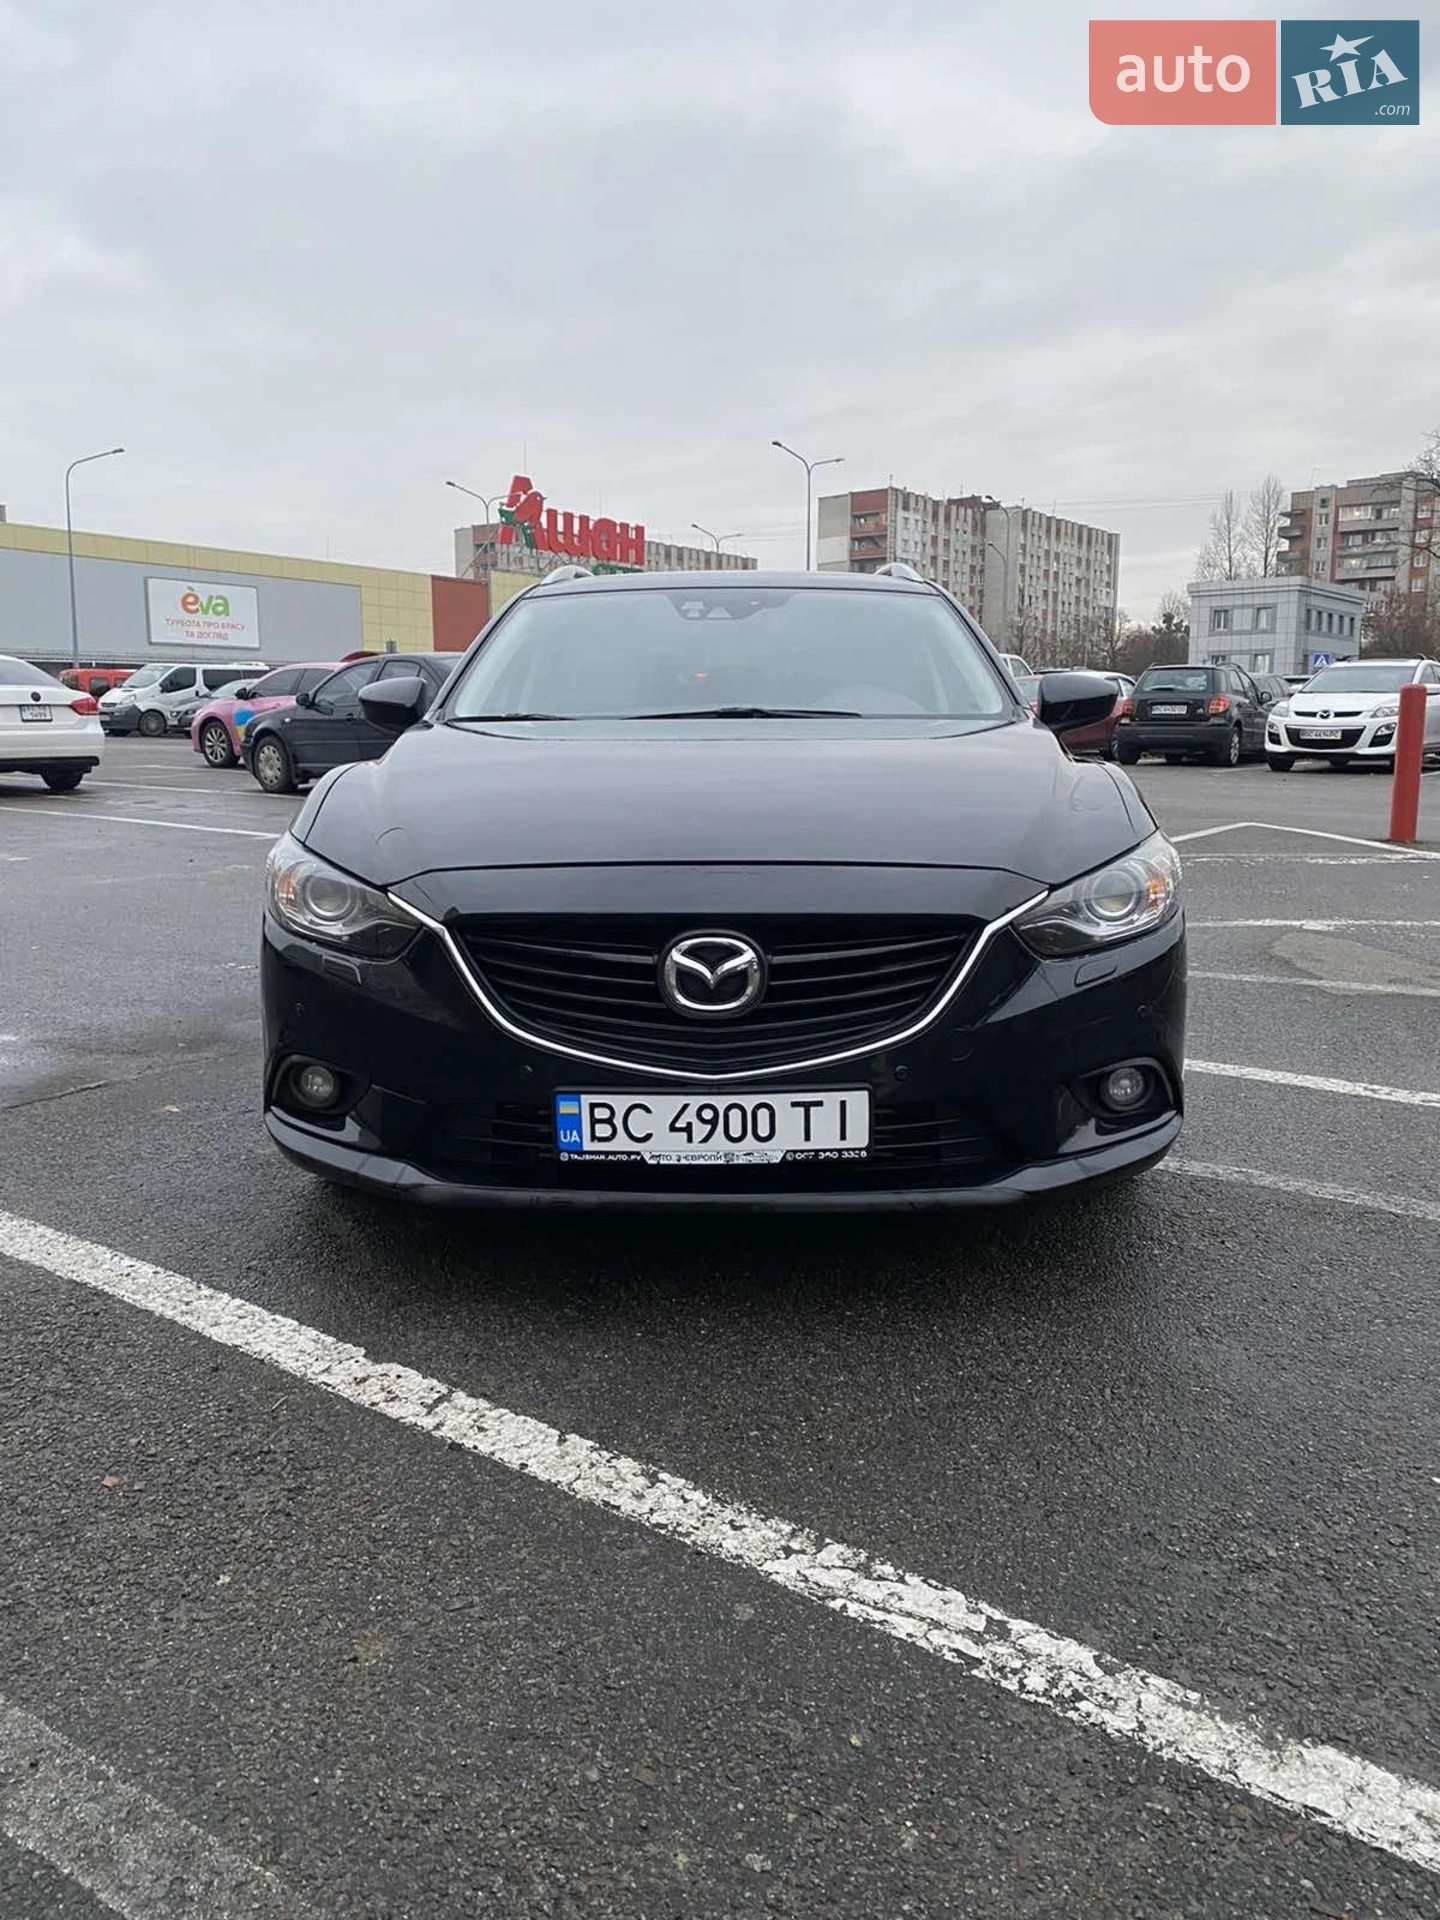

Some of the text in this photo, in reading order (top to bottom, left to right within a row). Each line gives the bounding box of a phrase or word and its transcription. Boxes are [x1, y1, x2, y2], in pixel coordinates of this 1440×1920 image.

[560, 1130, 580, 1142] UA
[589, 1102, 653, 1143] BC
[669, 1102, 776, 1144] 4900
